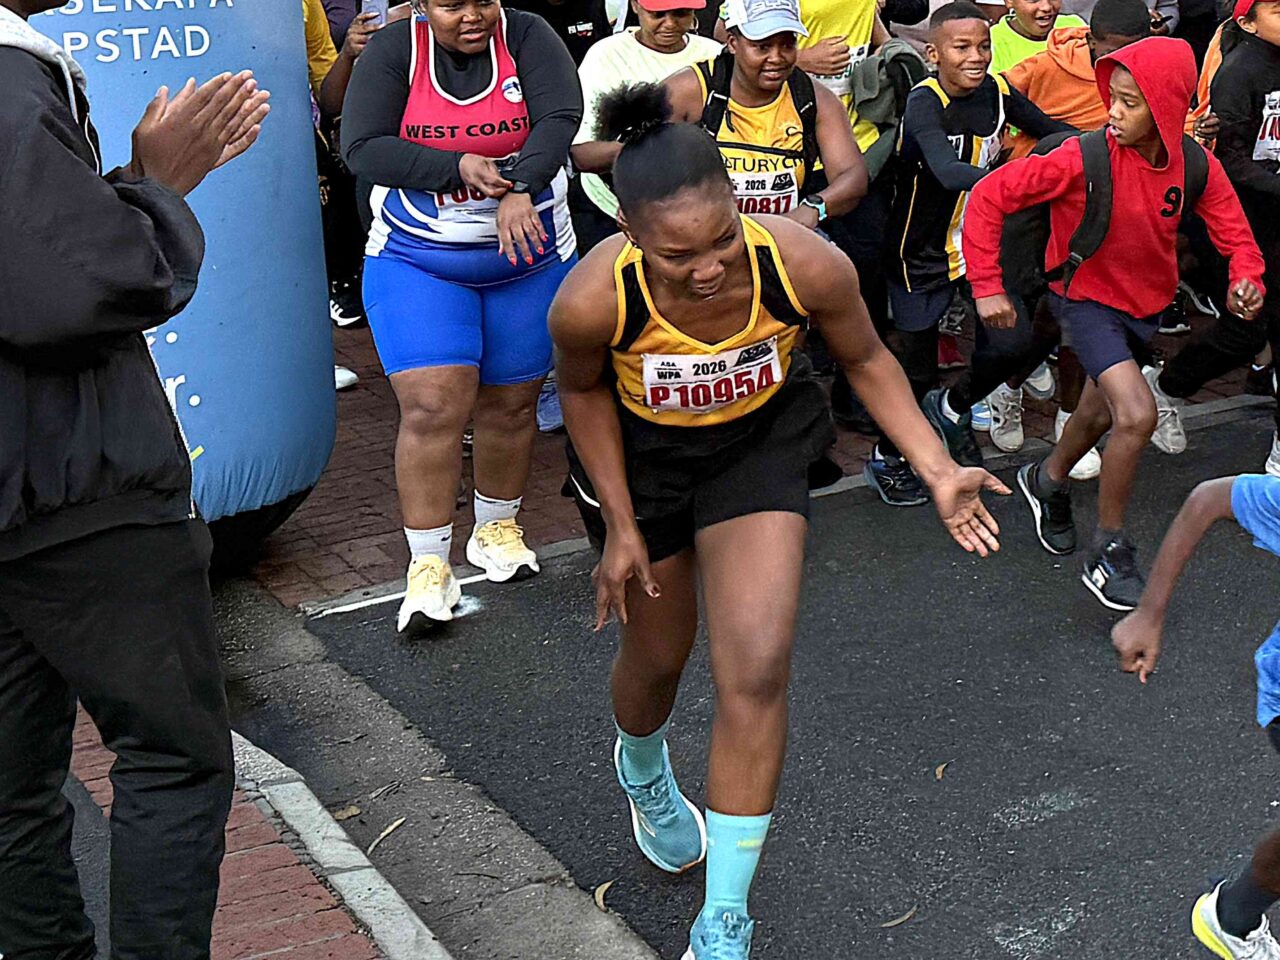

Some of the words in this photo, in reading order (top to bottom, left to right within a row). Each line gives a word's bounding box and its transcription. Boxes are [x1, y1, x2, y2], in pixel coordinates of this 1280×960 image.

[63, 25, 211, 63] PSTAD
[405, 124, 460, 139] WEST
[465, 116, 530, 137] COAST
[726, 157, 780, 172] TURY
[745, 179, 767, 191] 2026
[775, 173, 792, 185] ASA
[737, 194, 792, 215] 10817
[1161, 185, 1182, 217] 9
[656, 370, 682, 380] WPA
[692, 360, 727, 376] 2026
